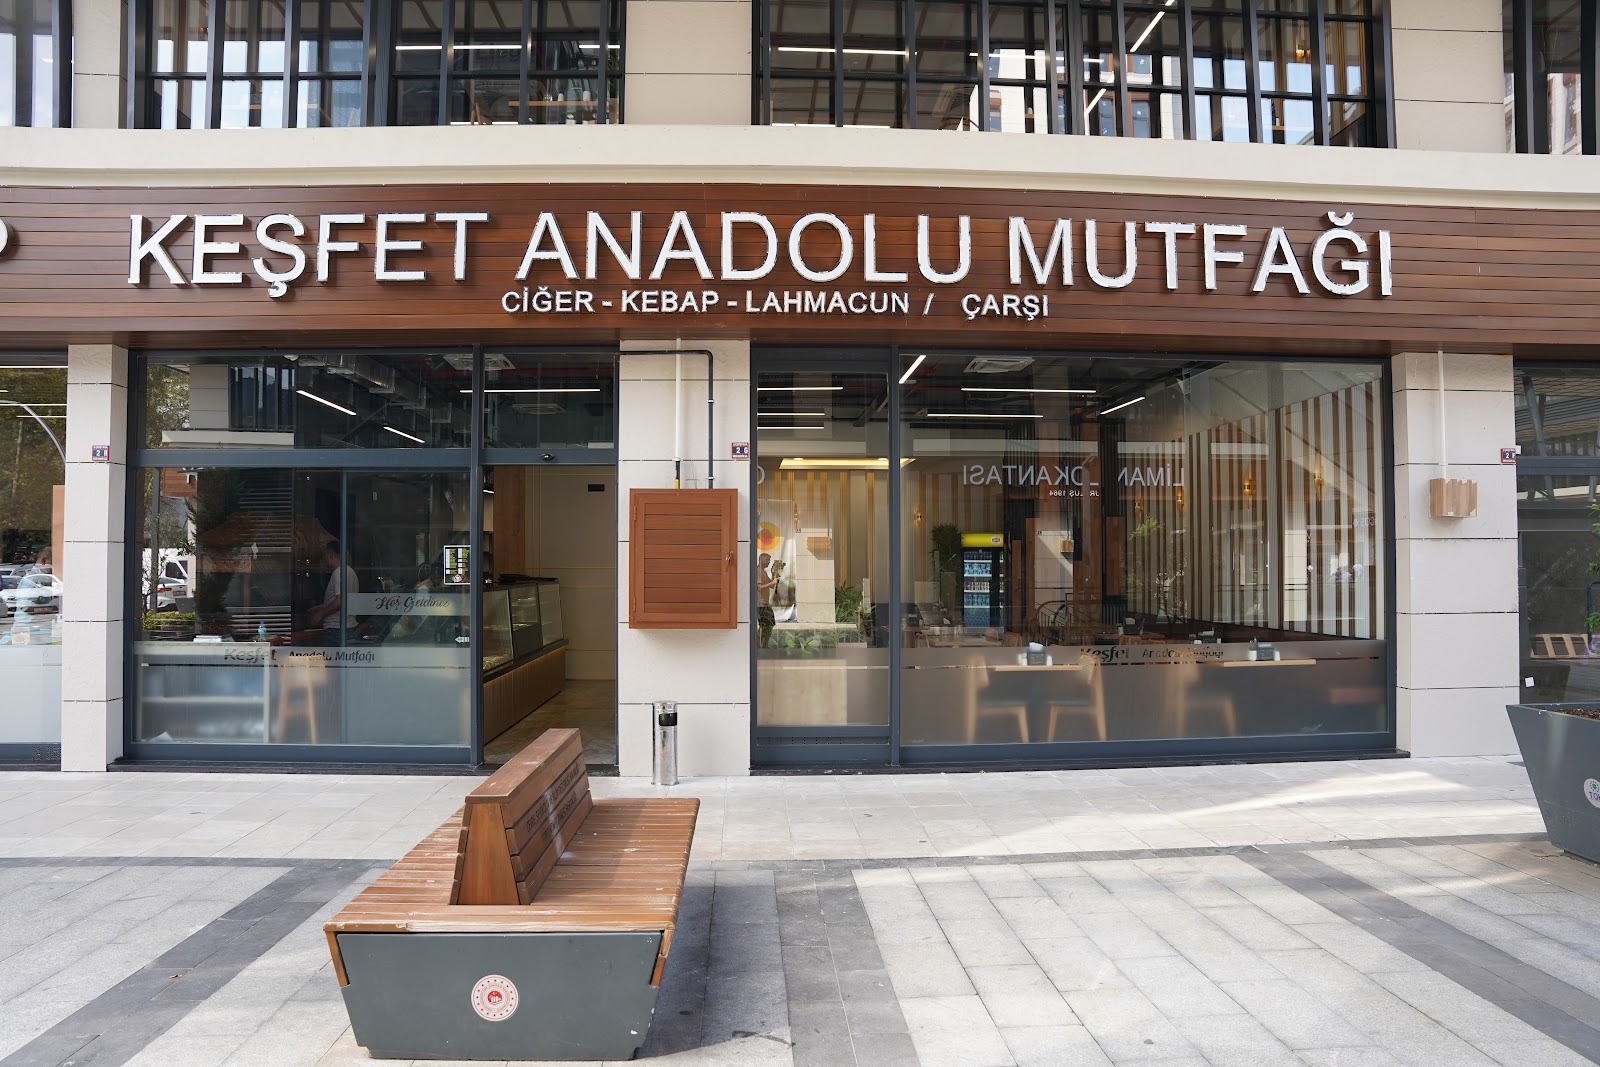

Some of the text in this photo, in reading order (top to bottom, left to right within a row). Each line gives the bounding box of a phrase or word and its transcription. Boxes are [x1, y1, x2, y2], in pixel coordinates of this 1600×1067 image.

[127, 210, 1393, 298] KEŞFET ANADOLU MUTFAĞI
[501, 286, 594, 313] CİĞER
[621, 289, 720, 313] KEBAP
[745, 290, 910, 315] LAHMACUN
[961, 293, 1049, 321] ÇARŞI
[375, 595, 450, 613] Hoş Geldiniz
[335, 649, 375, 664] Mutfağı
